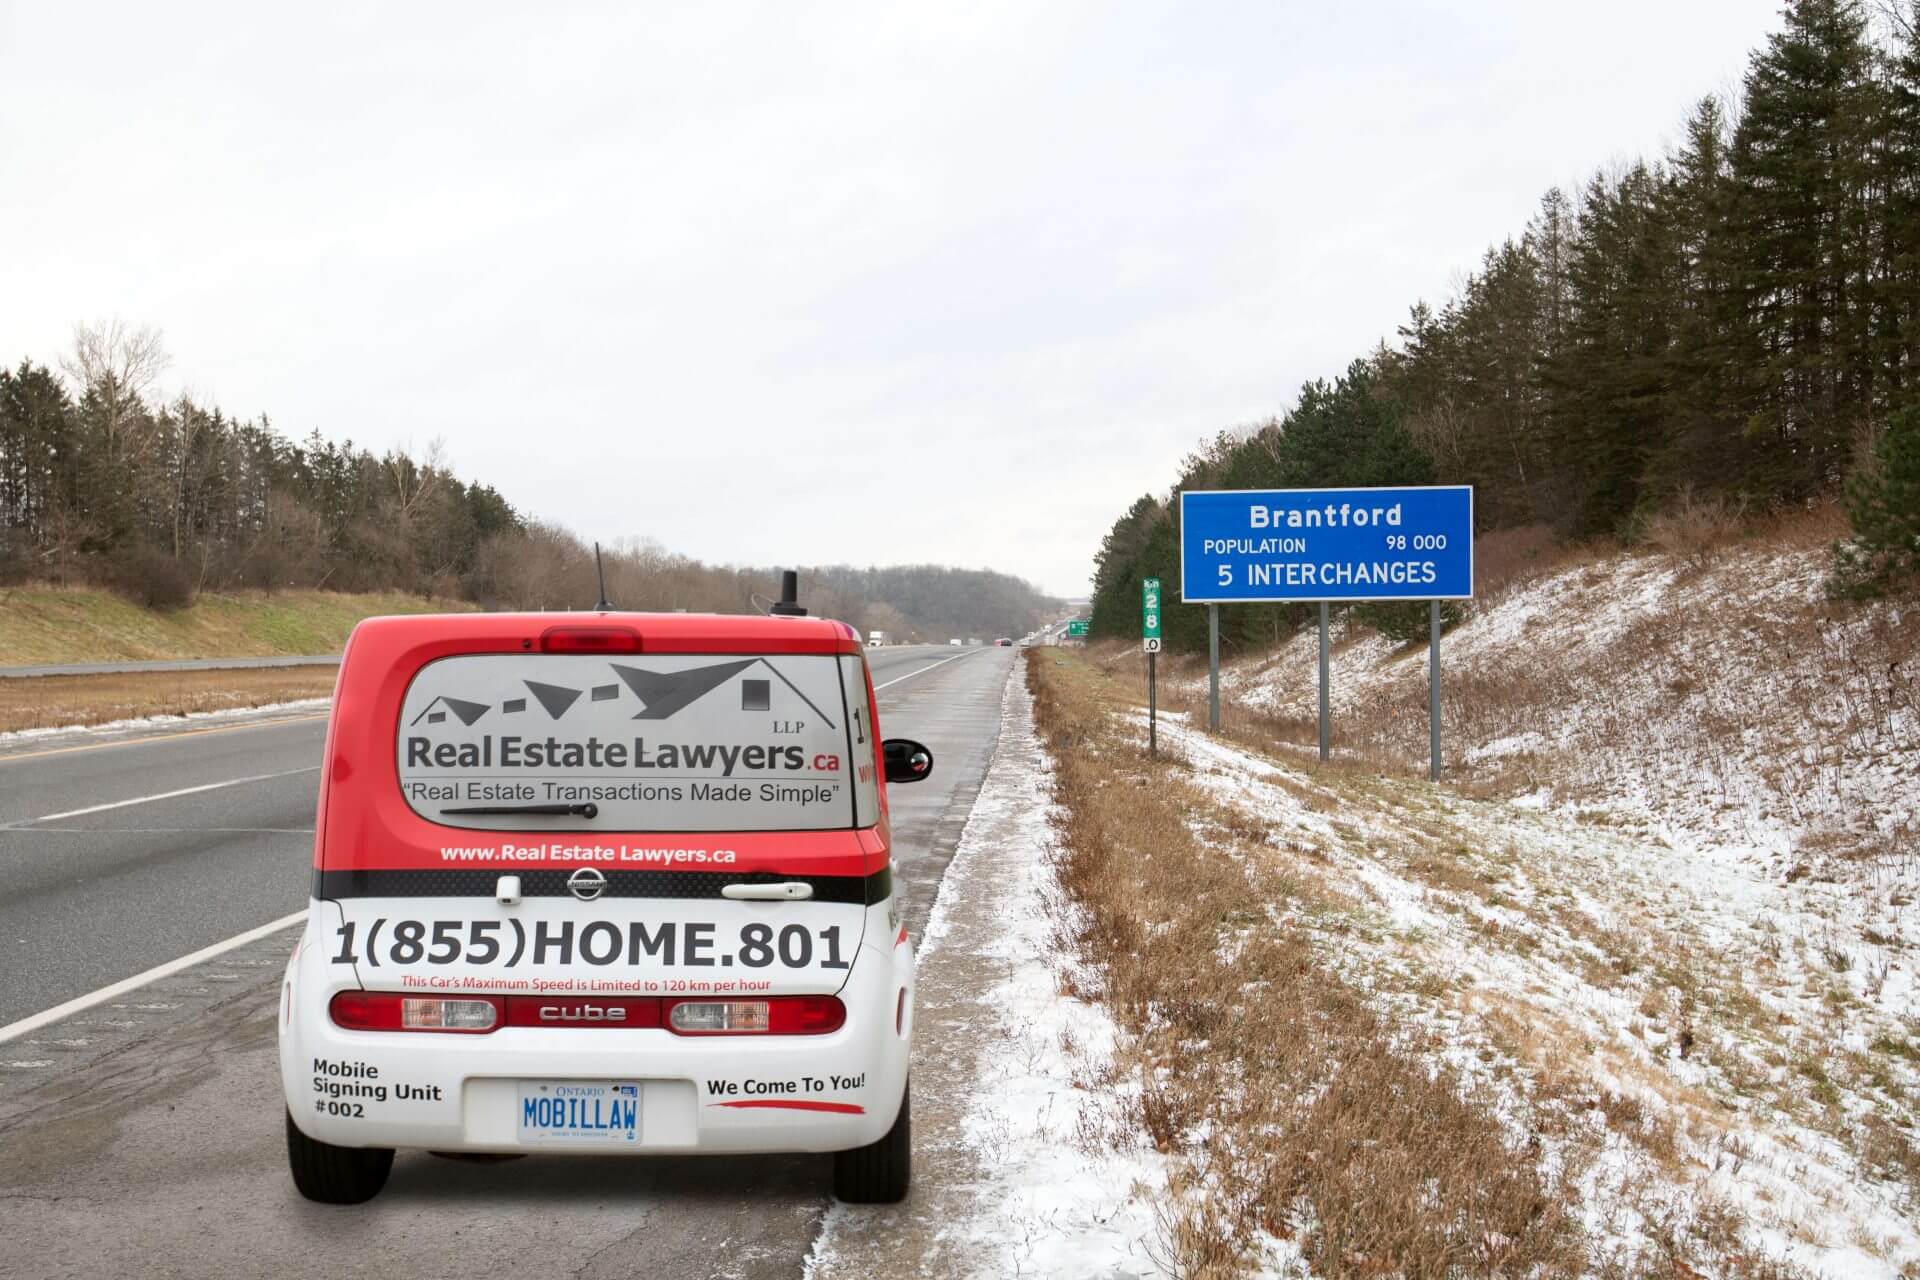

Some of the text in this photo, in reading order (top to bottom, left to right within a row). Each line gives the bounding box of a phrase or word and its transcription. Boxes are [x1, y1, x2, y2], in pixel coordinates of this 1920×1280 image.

[1250, 503, 1401, 529] Brantford
[1204, 535, 1447, 555] POPULATION 98 000
[1217, 561, 1437, 587] 5 INTERCHANGES
[773, 721, 805, 734] LLP
[467, 782, 535, 801] Estate
[542, 782, 682, 801] Transactions
[691, 783, 752, 802] Made
[550, 844, 615, 861] Estate
[620, 845, 736, 865] Lawyers.ca
[331, 918, 850, 970] 1(855)HOME.801
[401, 975, 427, 987] This
[463, 976, 529, 989] Maximum
[532, 977, 574, 993] Speed
[577, 978, 587, 990] is
[591, 979, 641, 991] Limited
[644, 980, 658, 991] to
[663, 980, 686, 991] 120
[689, 979, 710, 991] km
[714, 981, 736, 993] per
[739, 978, 770, 990] hour
[539, 1004, 626, 1021] cube
[313, 1058, 379, 1079] Mobile
[313, 1076, 442, 1102] Signing Unit
[556, 1086, 605, 1097] ONTARIO
[707, 1072, 865, 1095] We Come To You!
[315, 1098, 365, 1119] #002
[523, 1097, 637, 1129] MOBILLAW
